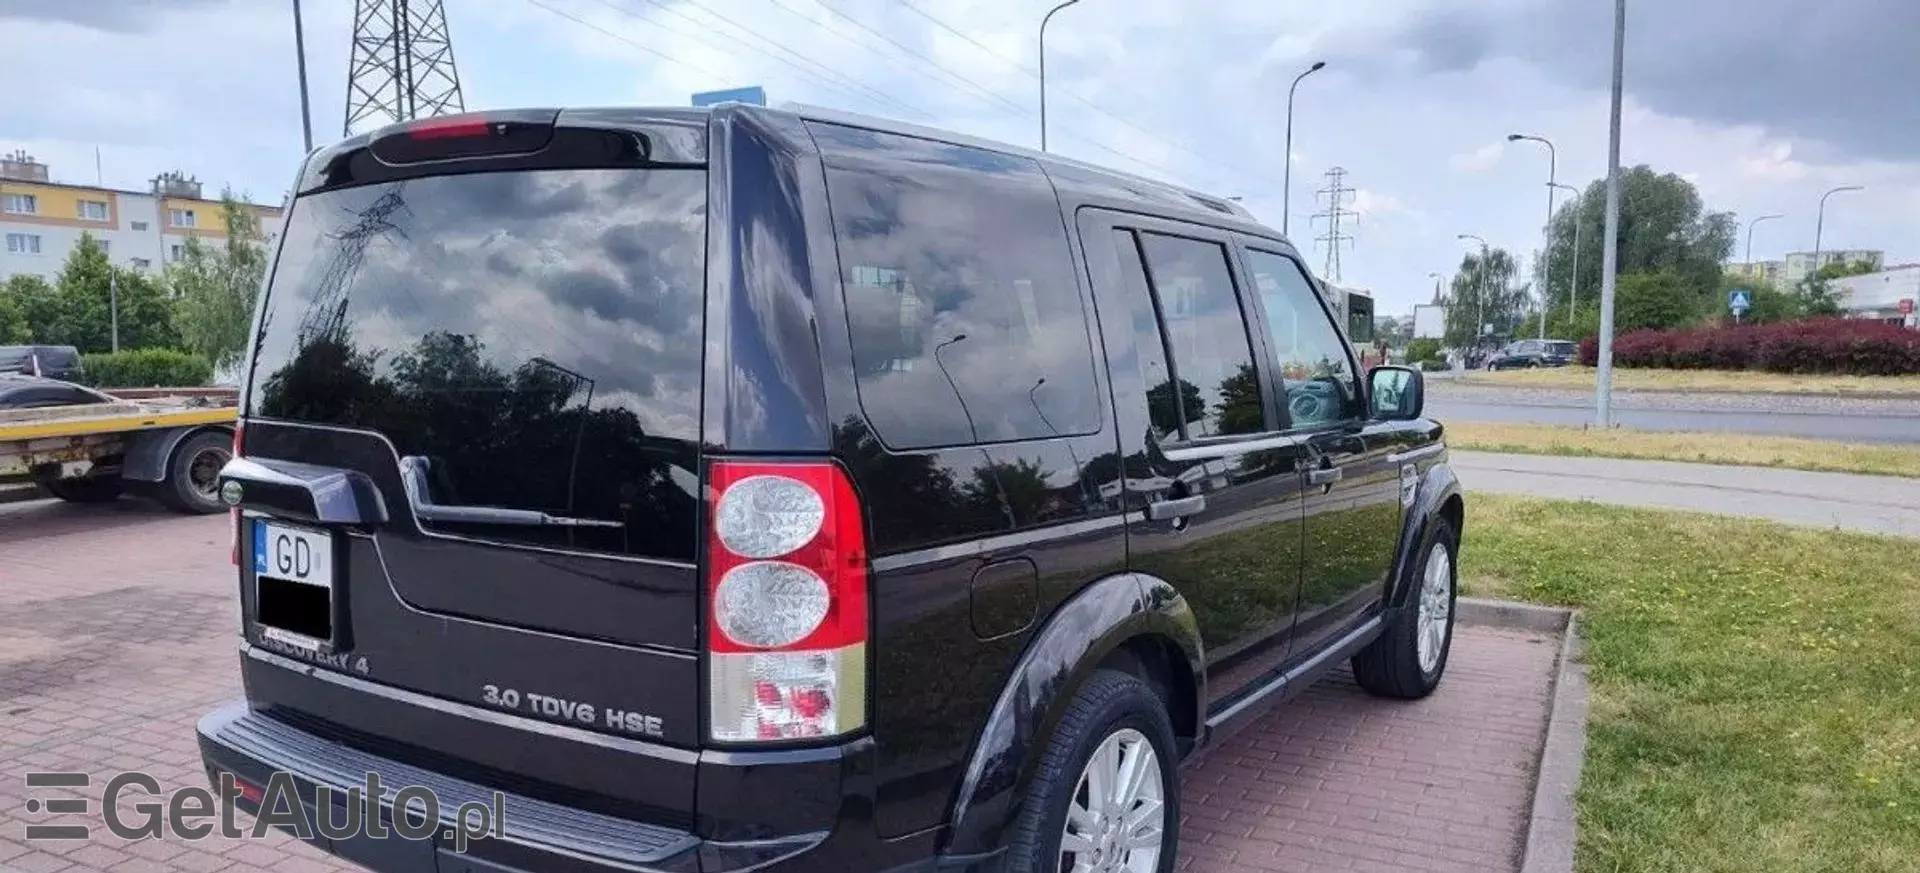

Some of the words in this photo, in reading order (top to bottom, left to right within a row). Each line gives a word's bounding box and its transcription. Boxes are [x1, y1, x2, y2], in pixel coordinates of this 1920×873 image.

[277, 534, 311, 578] GD
[355, 656, 371, 674] 4
[482, 684, 521, 709] 3.0
[527, 692, 595, 724] TDV6
[606, 708, 664, 738] HSE
